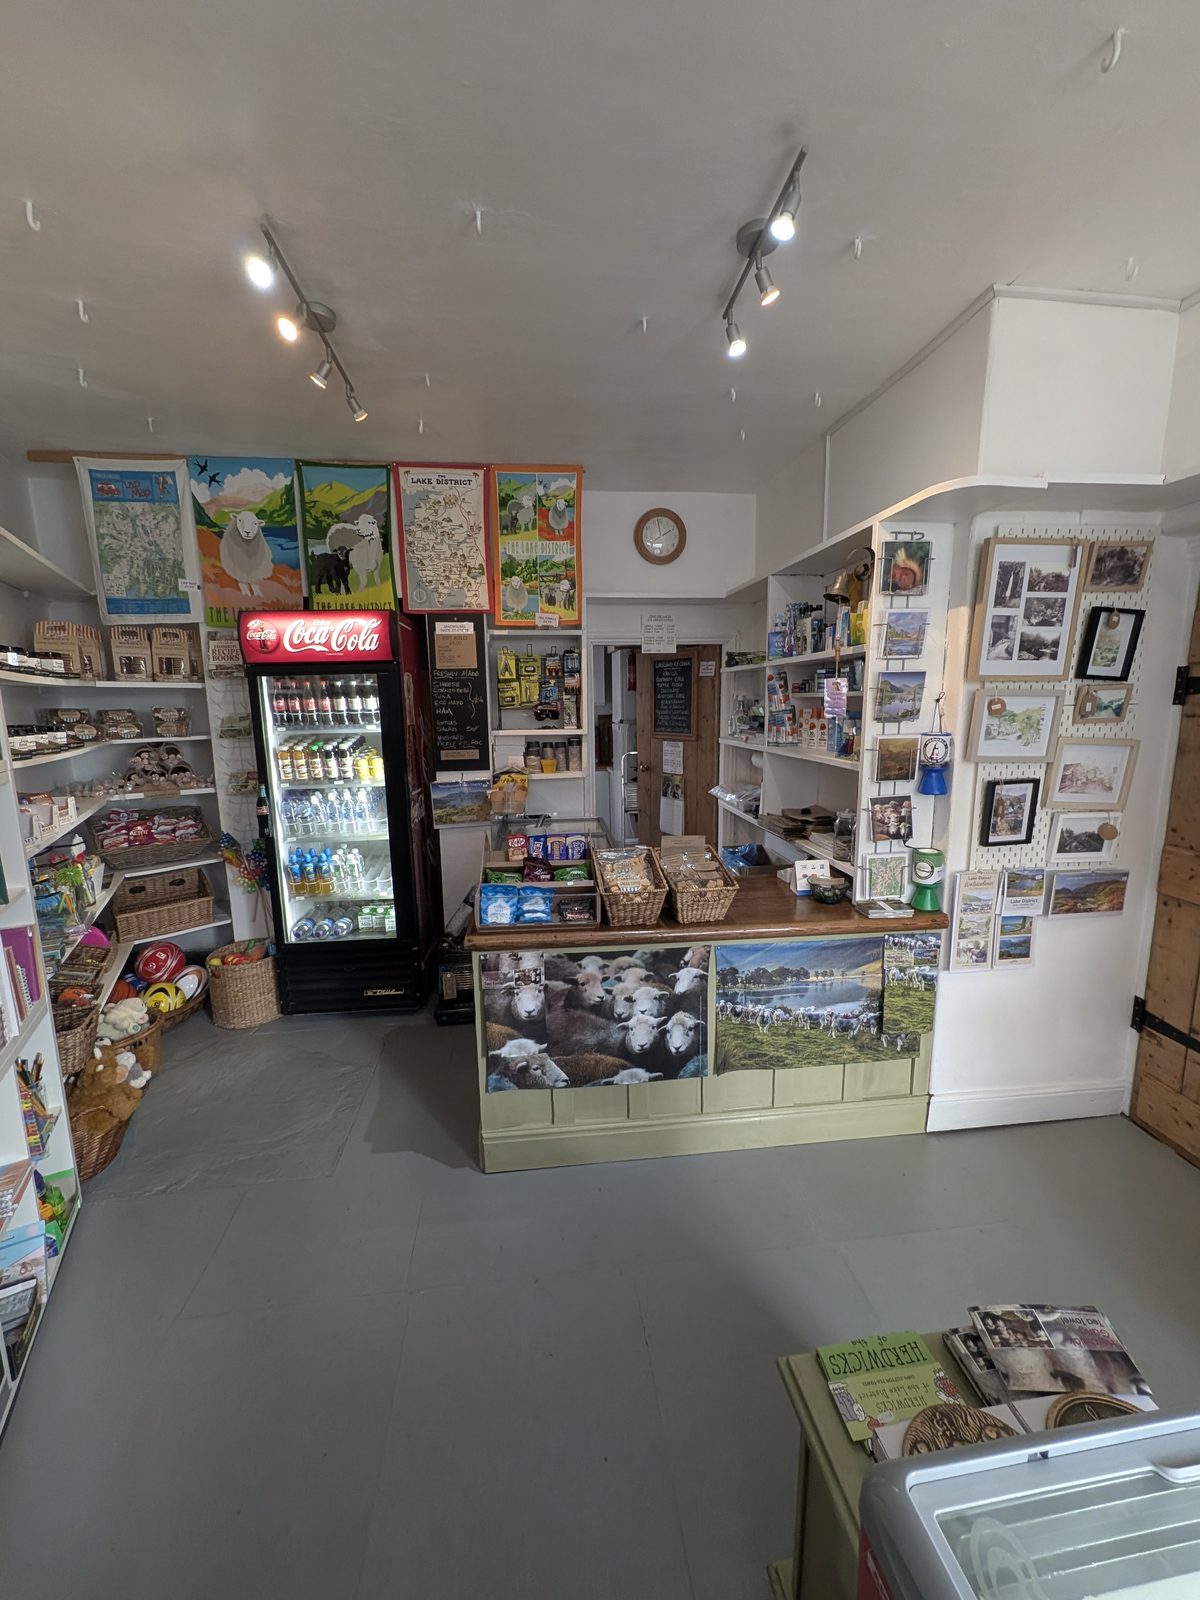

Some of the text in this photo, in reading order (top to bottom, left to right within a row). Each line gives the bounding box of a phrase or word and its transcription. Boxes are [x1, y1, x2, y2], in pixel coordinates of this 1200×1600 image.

[410, 477, 473, 487] LAKE DISTRICT
[540, 542, 570, 555] DISTRICT
[208, 606, 230, 623] THE
[283, 618, 383, 653] Coca-Cola
[212, 648, 242, 656] RECIPE
[436, 707, 454, 716] HAM
[850, 1335, 888, 1348] of the
[828, 1340, 927, 1376] HERDWICKS
[857, 1387, 889, 1401] District
[888, 1385, 907, 1397] Lake
[907, 1384, 919, 1394] the
[875, 1394, 928, 1413] HERDWICKS
